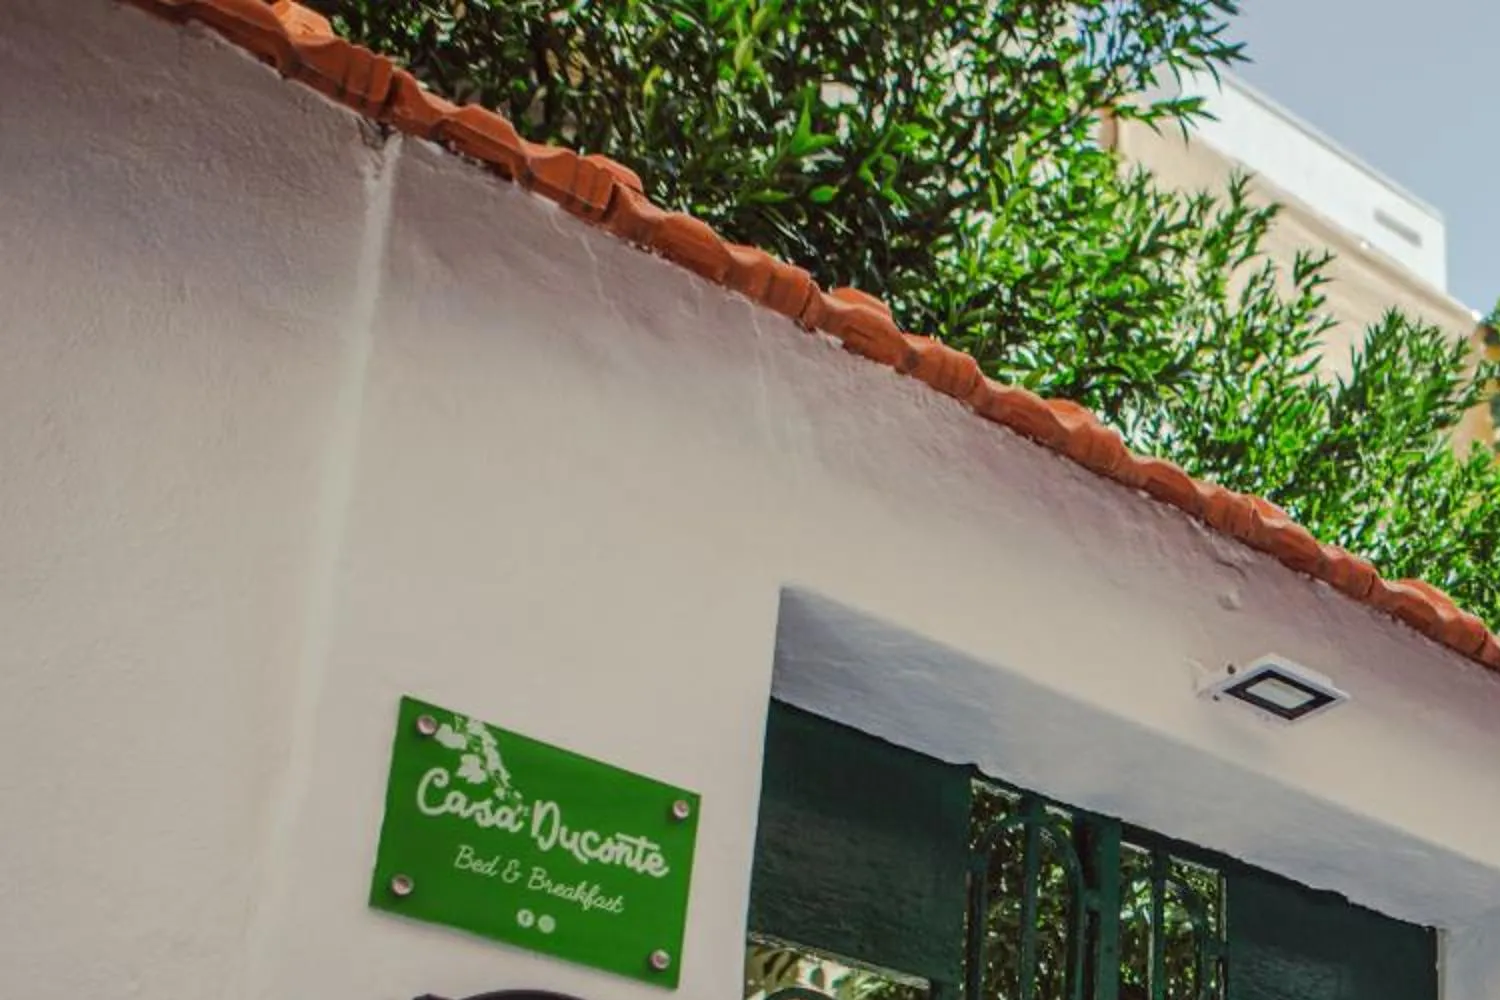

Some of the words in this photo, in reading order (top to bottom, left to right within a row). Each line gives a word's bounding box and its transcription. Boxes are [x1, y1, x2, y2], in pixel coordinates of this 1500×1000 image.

[417, 767, 524, 833] Casa
[454, 845, 499, 877] Bed
[501, 859, 522, 883] &
[528, 867, 625, 913] Breakfast
